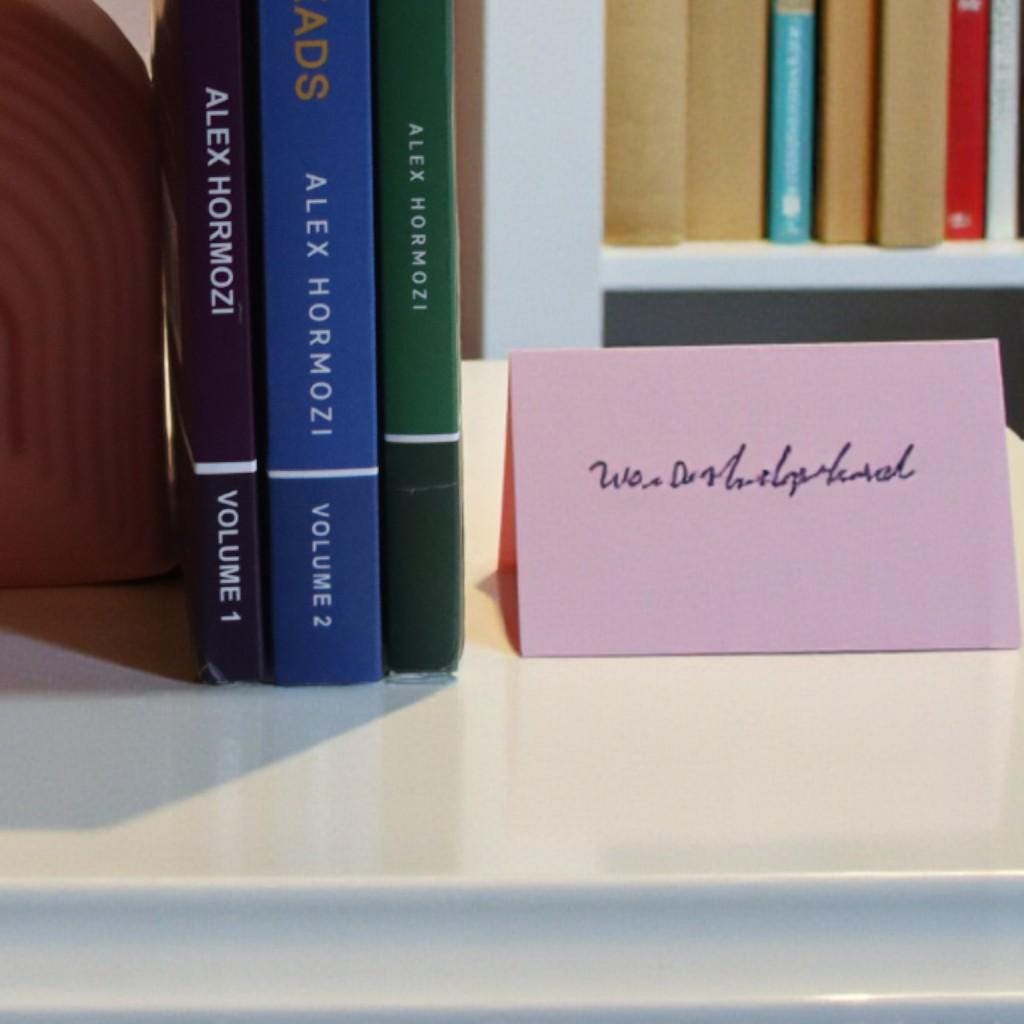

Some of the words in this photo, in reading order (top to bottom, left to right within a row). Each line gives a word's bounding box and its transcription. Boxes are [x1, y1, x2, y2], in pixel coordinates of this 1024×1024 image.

[205, 86, 231, 167] ALEX
[408, 123, 425, 182] ALEX
[208, 175, 235, 315] HORMOZI
[305, 173, 330, 258] ALEX
[410, 196, 428, 310] HORMOZI
[308, 277, 333, 435] HORMOZI
[217, 489, 242, 603] VOLUME
[311, 503, 332, 607] VOLUME
[219, 611, 242, 622] 1
[313, 616, 332, 627] 2
